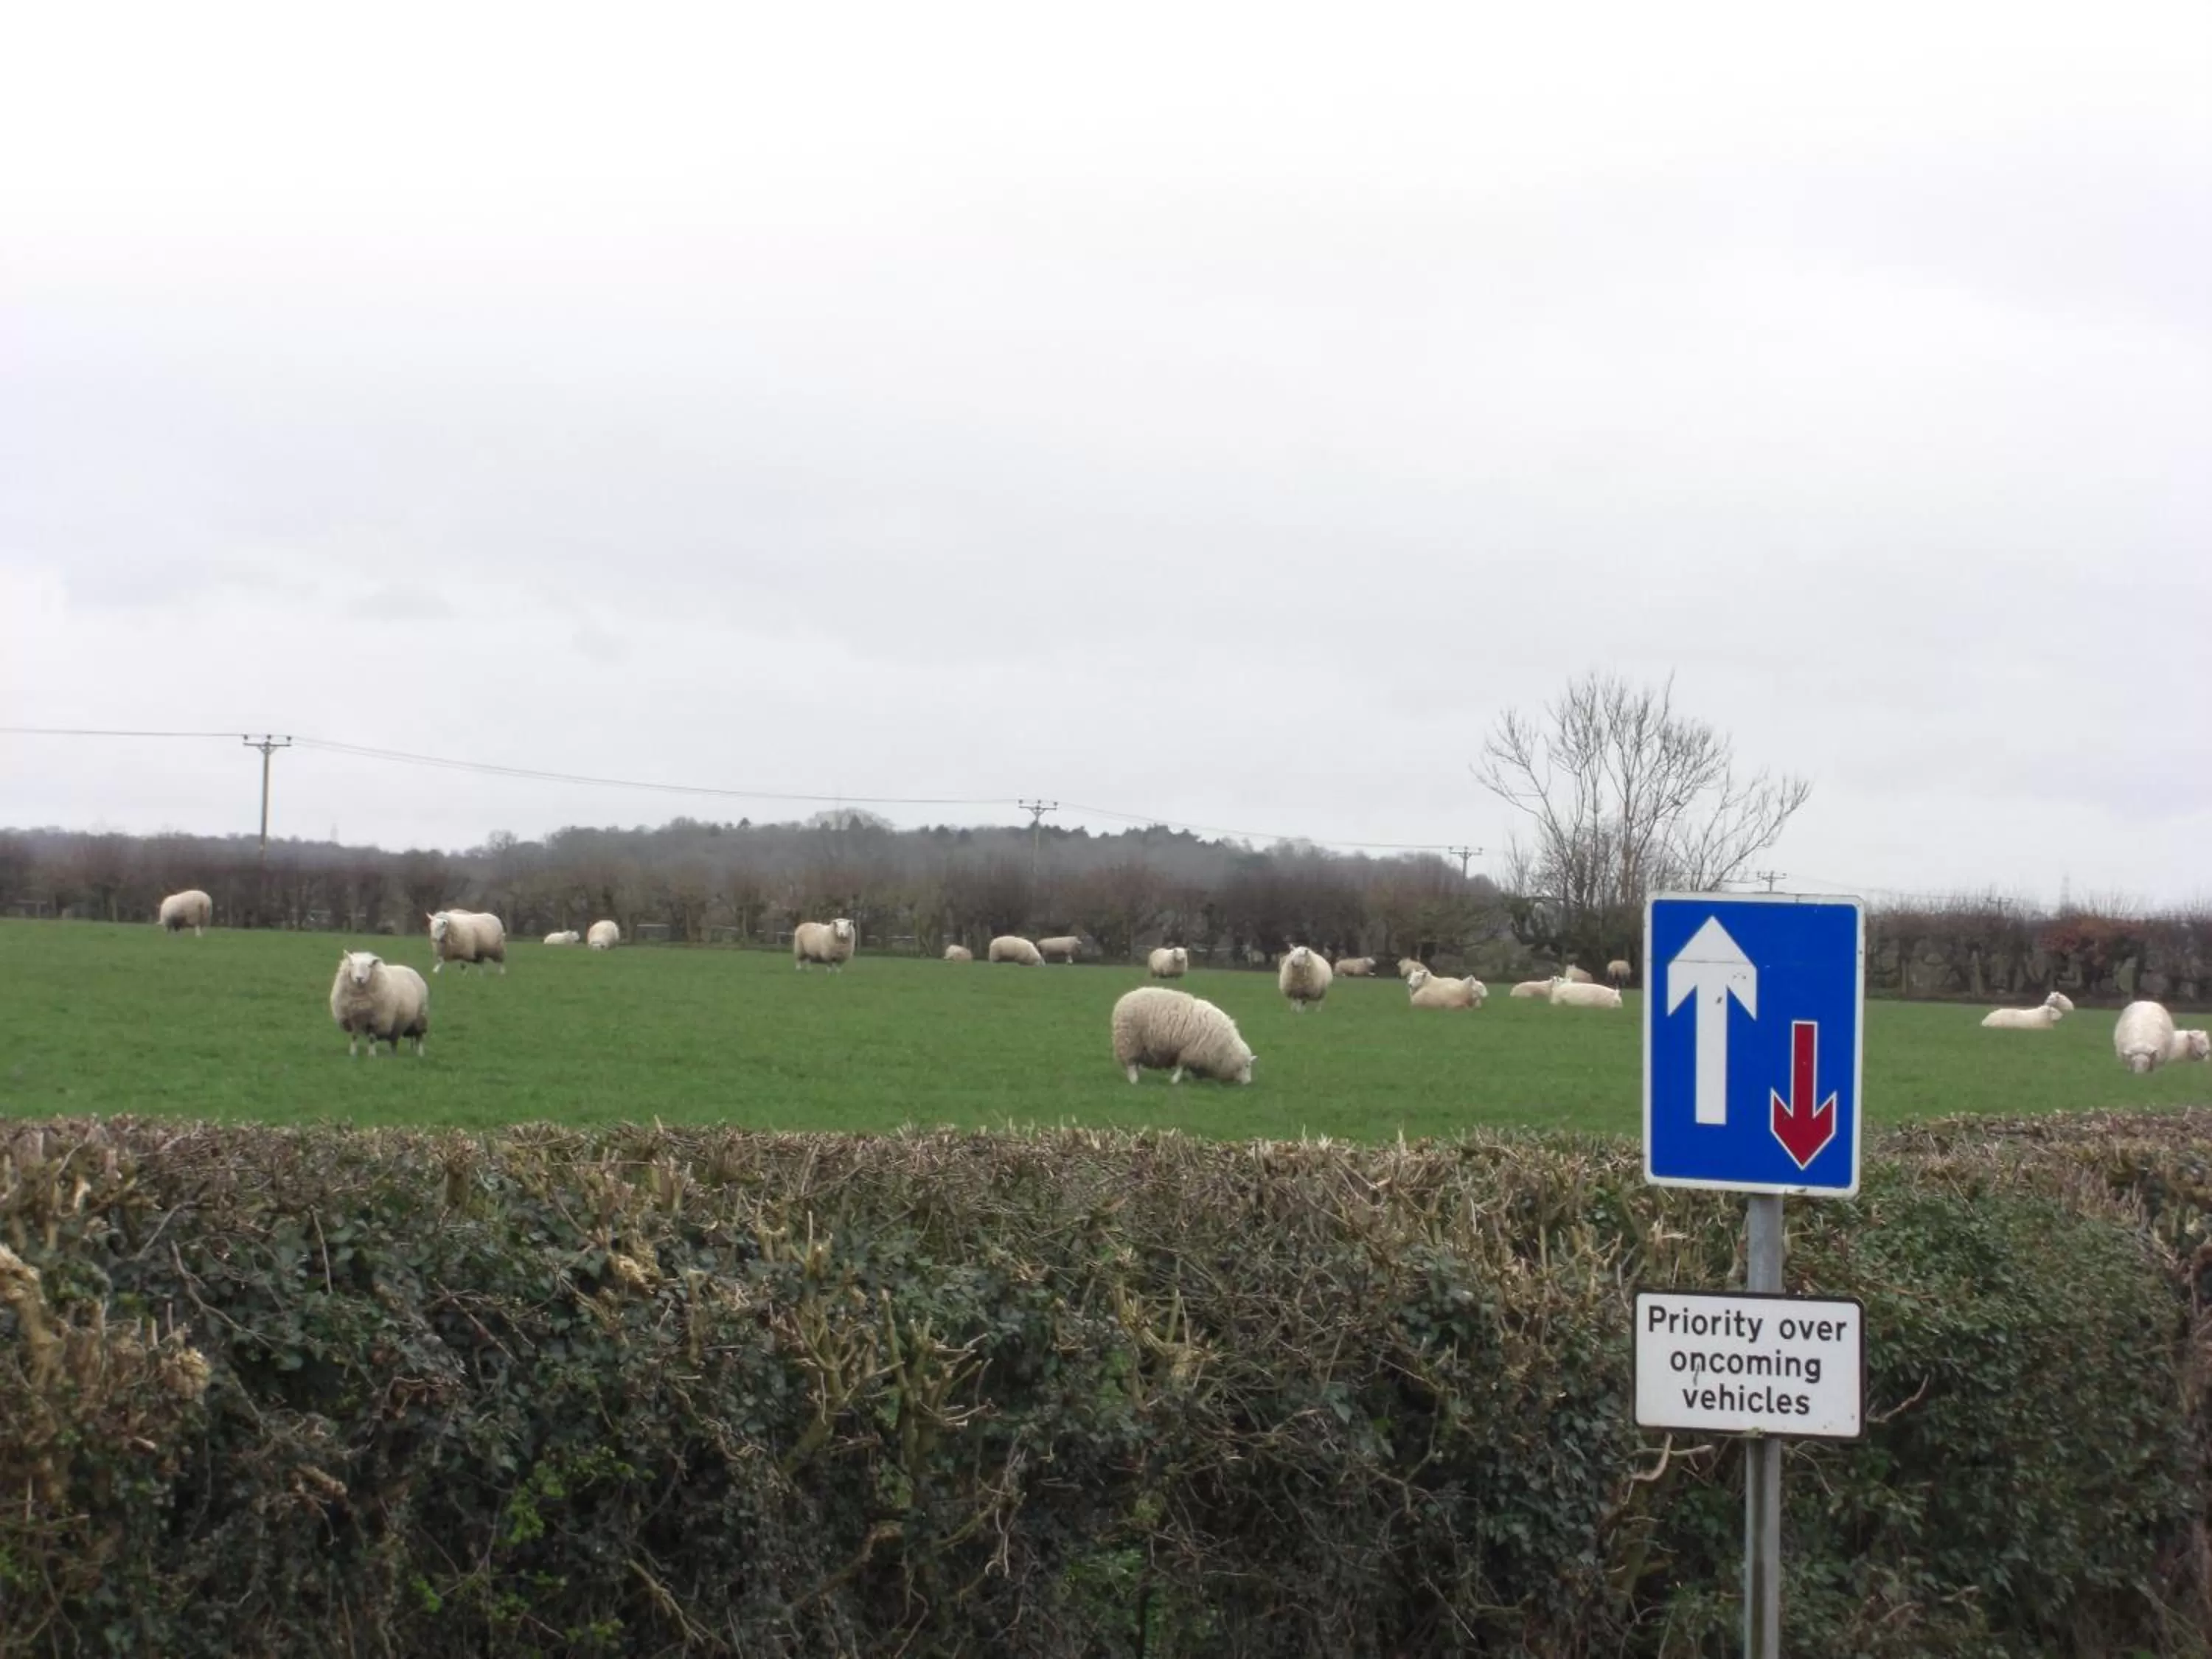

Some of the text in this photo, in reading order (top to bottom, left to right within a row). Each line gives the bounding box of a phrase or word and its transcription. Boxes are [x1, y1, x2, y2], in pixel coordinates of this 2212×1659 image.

[1648, 1305, 1847, 1343] Priority over
[1670, 1349, 1821, 1384] oncoming
[1682, 1383, 1811, 1416] vehicles
